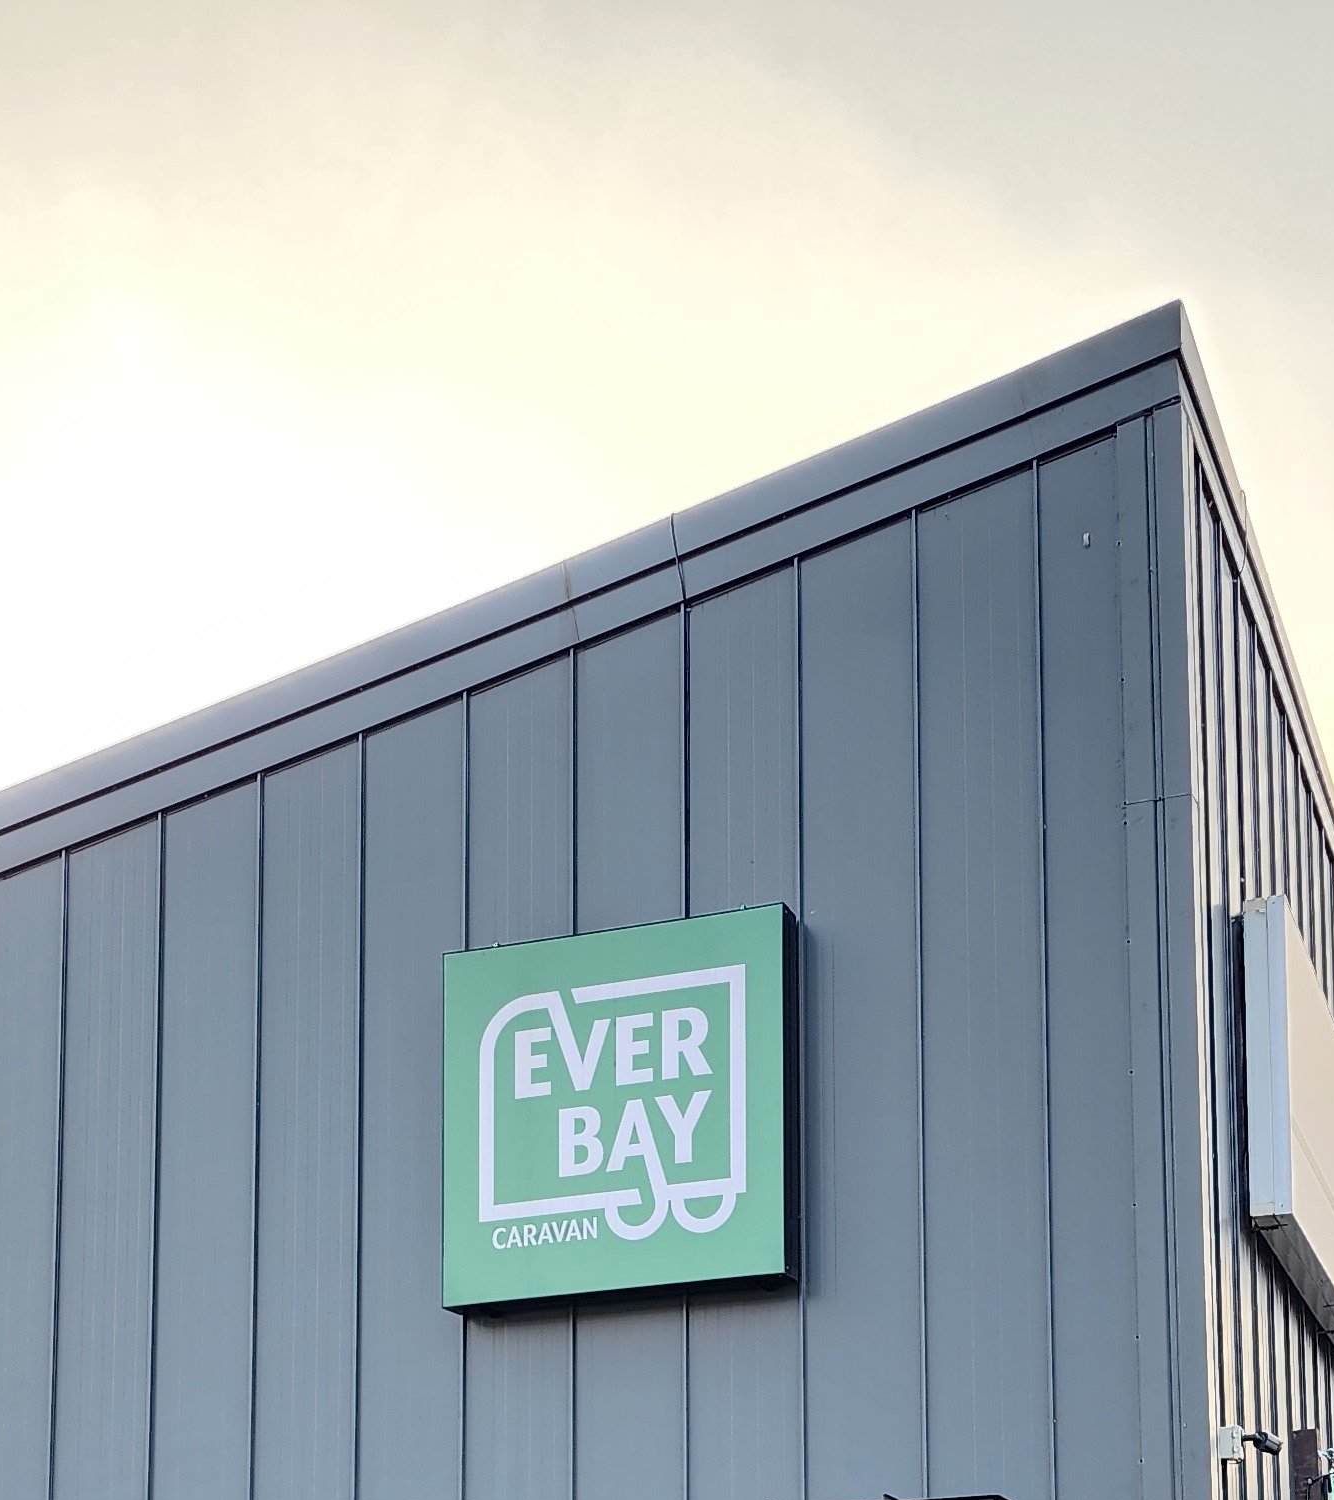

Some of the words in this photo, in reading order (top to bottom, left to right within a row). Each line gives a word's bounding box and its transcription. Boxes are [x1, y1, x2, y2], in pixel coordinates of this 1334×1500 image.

[515, 1007, 713, 1099] EVER
[559, 1090, 713, 1178] BAY
[492, 1217, 598, 1250] CARAVAN
